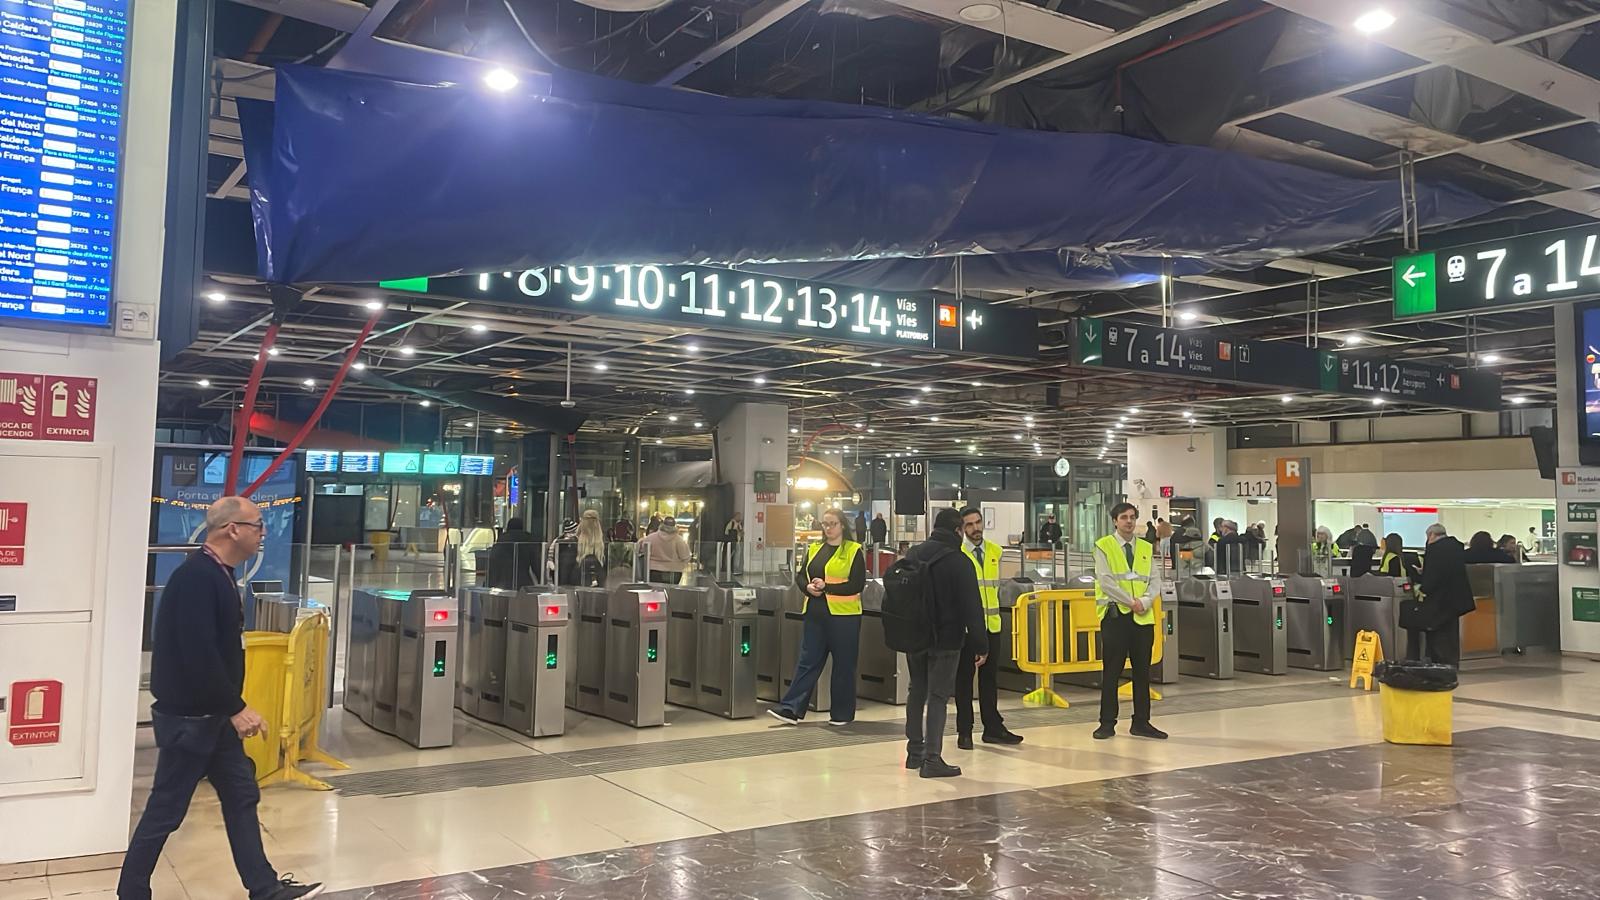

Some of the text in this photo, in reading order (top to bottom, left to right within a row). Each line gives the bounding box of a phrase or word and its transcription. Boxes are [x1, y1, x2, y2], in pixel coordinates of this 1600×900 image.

[18, 120, 40, 130] Nord
[4, 151, 35, 163] França
[1, 184, 33, 196] França
[8, 251, 31, 261] Nord
[1477, 235, 1600, 299] 7 a 14
[896, 298, 916, 312] Vías
[940, 308, 950, 322] R
[1124, 328, 1185, 368] 7 a 14
[46, 428, 89, 436] EXTINTOR
[1286, 461, 1300, 477] R
[178, 490, 209, 500] Porta
[13, 731, 56, 740] EXTINTOR
